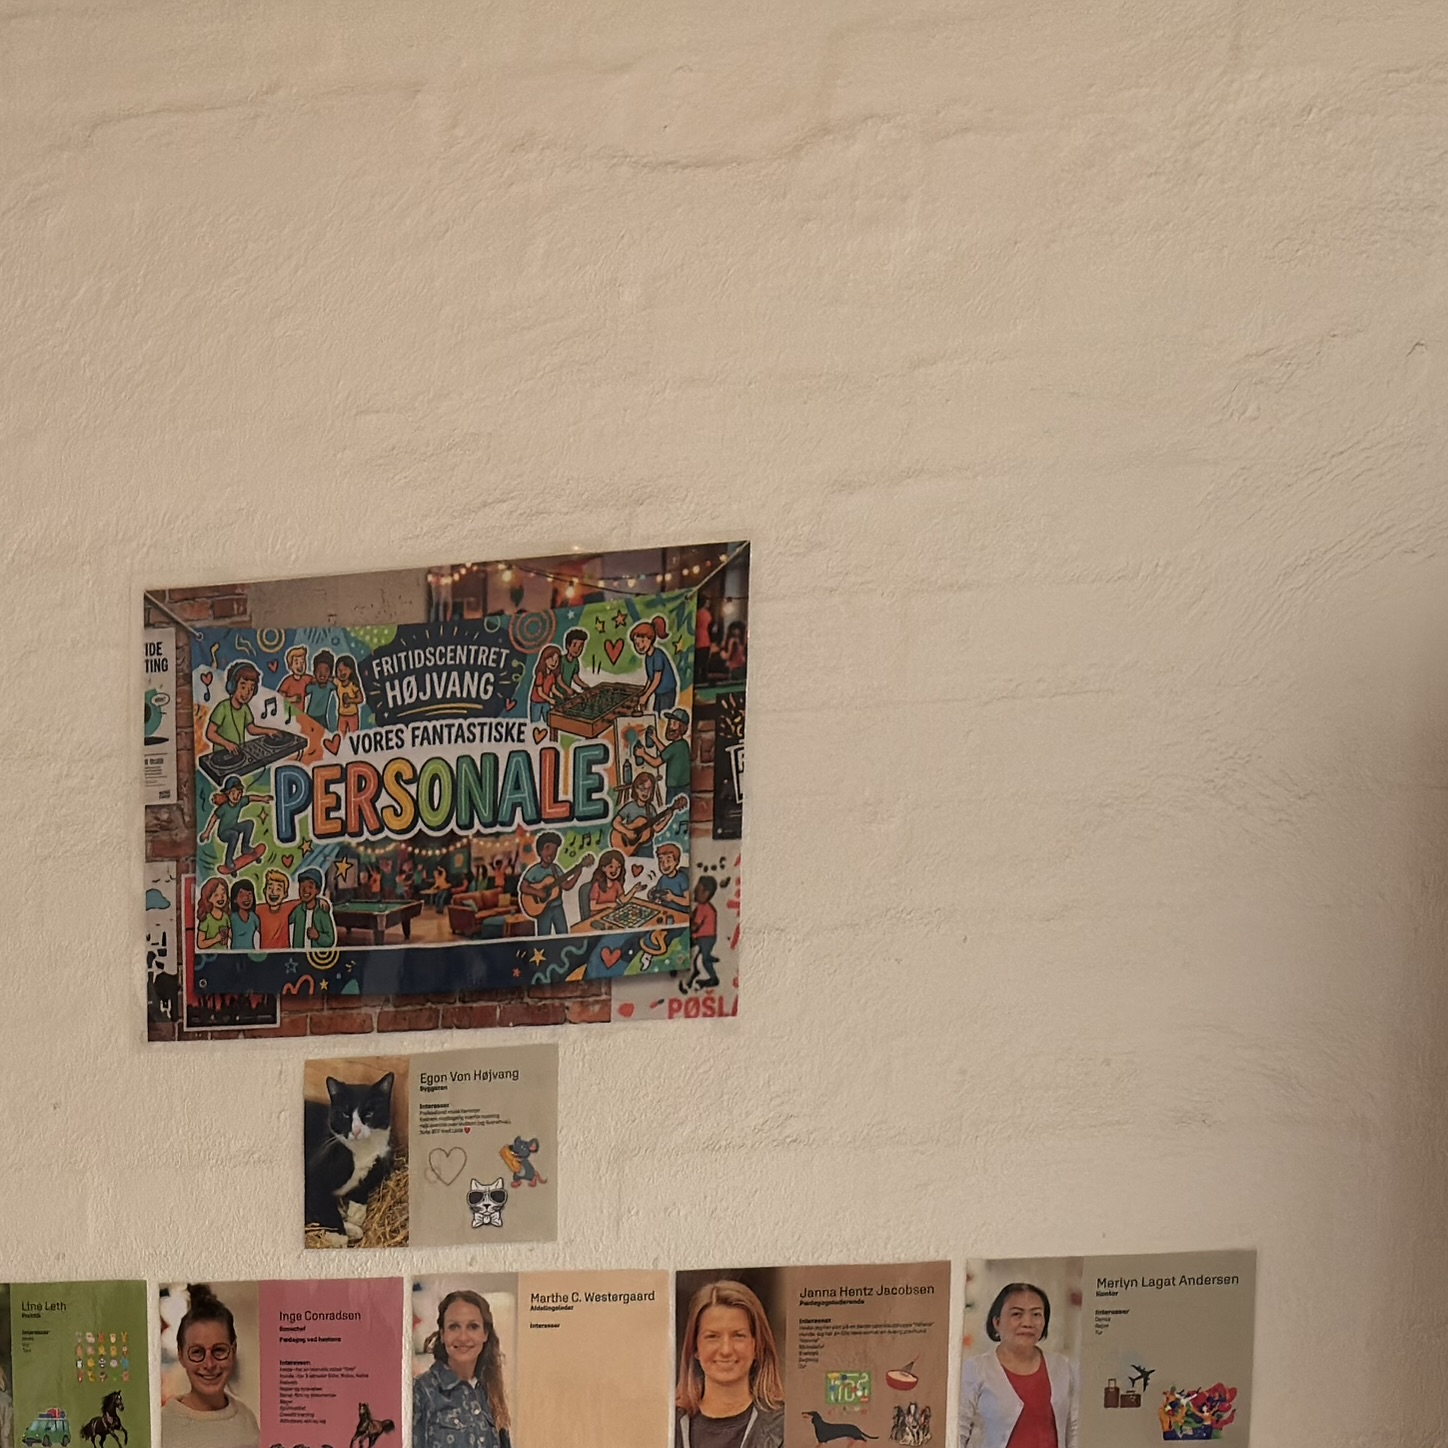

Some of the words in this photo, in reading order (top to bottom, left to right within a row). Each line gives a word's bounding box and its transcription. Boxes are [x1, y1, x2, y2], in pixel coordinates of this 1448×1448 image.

[372, 645, 510, 679] FRITIDSCENTRET
[386, 671, 495, 708] HØJVANG
[349, 729, 405, 755] VORES
[411, 722, 527, 748] FANTASTISKE
[273, 744, 610, 842] PERSONALE
[420, 1072, 447, 1085] Egon
[451, 1072, 470, 1083] Von
[474, 1069, 519, 1083] Højvang
[1097, 1277, 1138, 1290] Merlyn
[1141, 1276, 1175, 1289] Lagat
[1179, 1275, 1239, 1285] Andersen
[531, 1293, 568, 1303] Marthe
[571, 1292, 582, 1302] C.
[585, 1291, 654, 1303] Westergaard
[800, 1288, 836, 1298] Janna
[840, 1286, 874, 1296] Hentz
[876, 1285, 934, 1296] Jacobsen
[21, 1302, 42, 1311] Line
[45, 1302, 66, 1311] Leth
[280, 1311, 302, 1323] Inge
[305, 1311, 361, 1320] Conradsen
